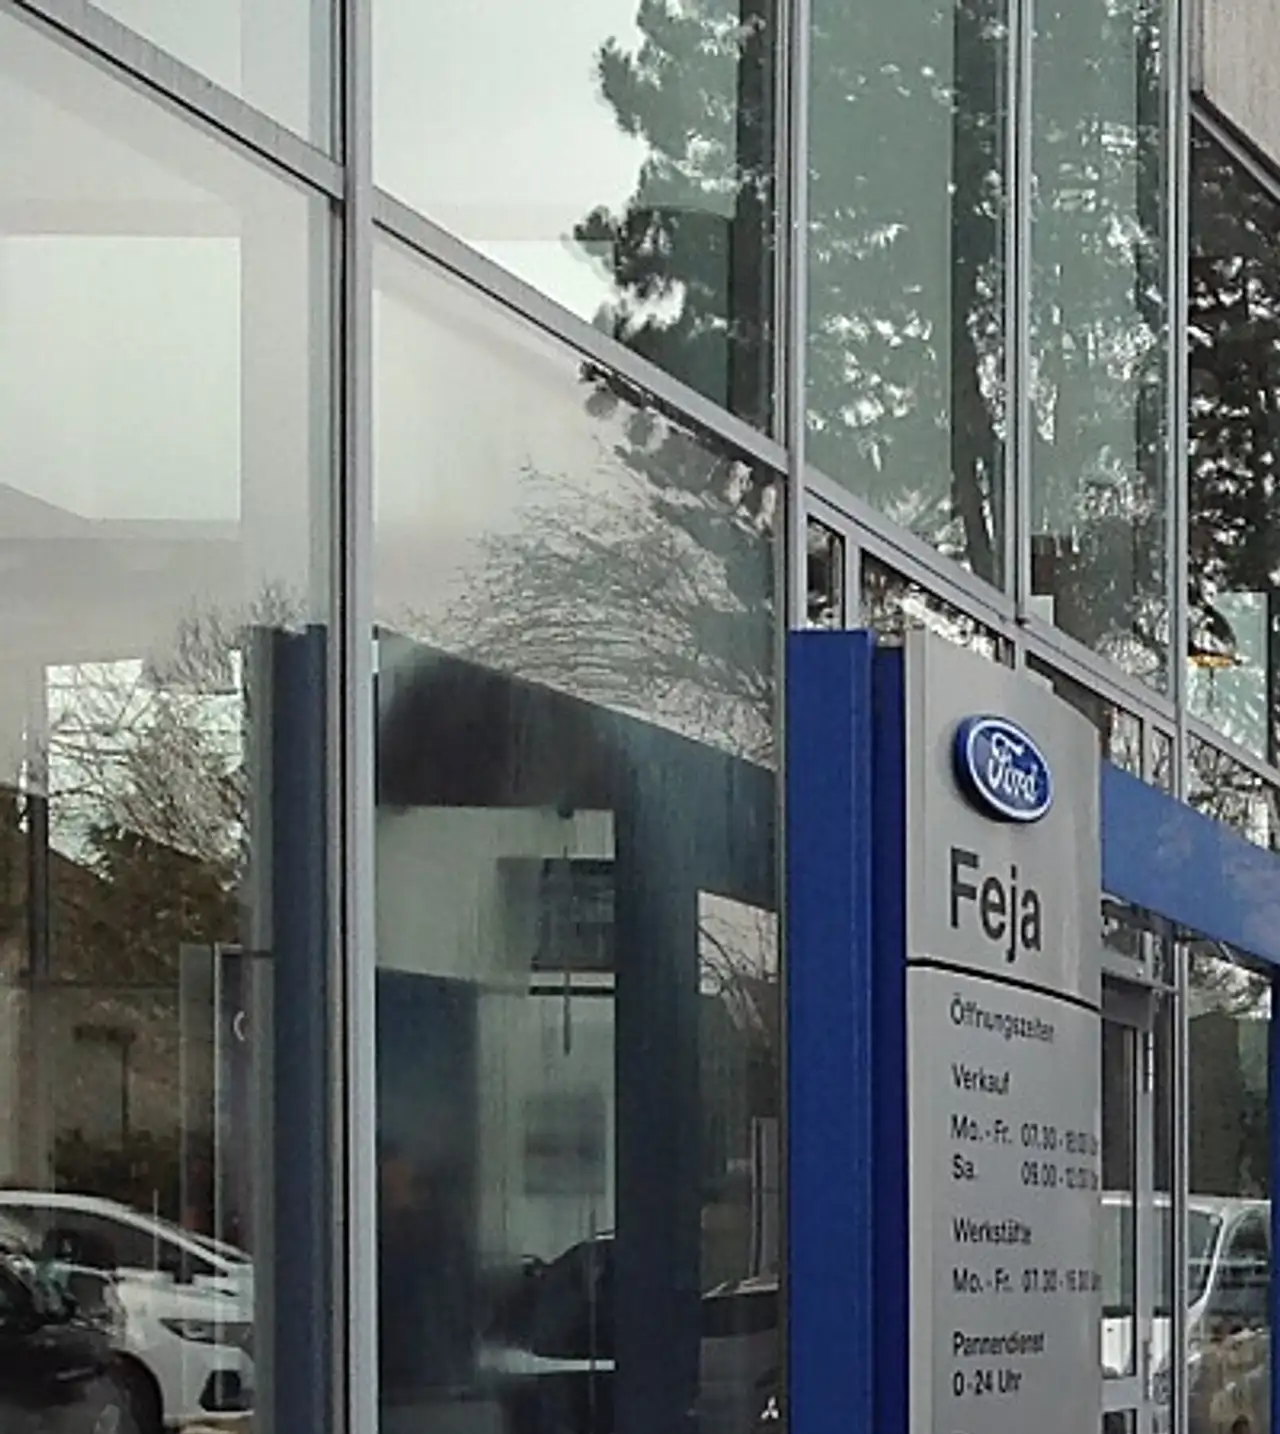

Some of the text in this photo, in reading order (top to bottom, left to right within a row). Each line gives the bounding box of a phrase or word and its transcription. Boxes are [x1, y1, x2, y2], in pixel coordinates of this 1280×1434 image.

[988, 733, 1038, 802] Ford
[950, 847, 1042, 963] Feja
[950, 992, 1055, 1042] Öffnungszeiten
[952, 1063, 1011, 1094] Verkauf
[953, 1217, 1032, 1245] Werkstätte
[998, 1369, 1022, 1394] Uhr
